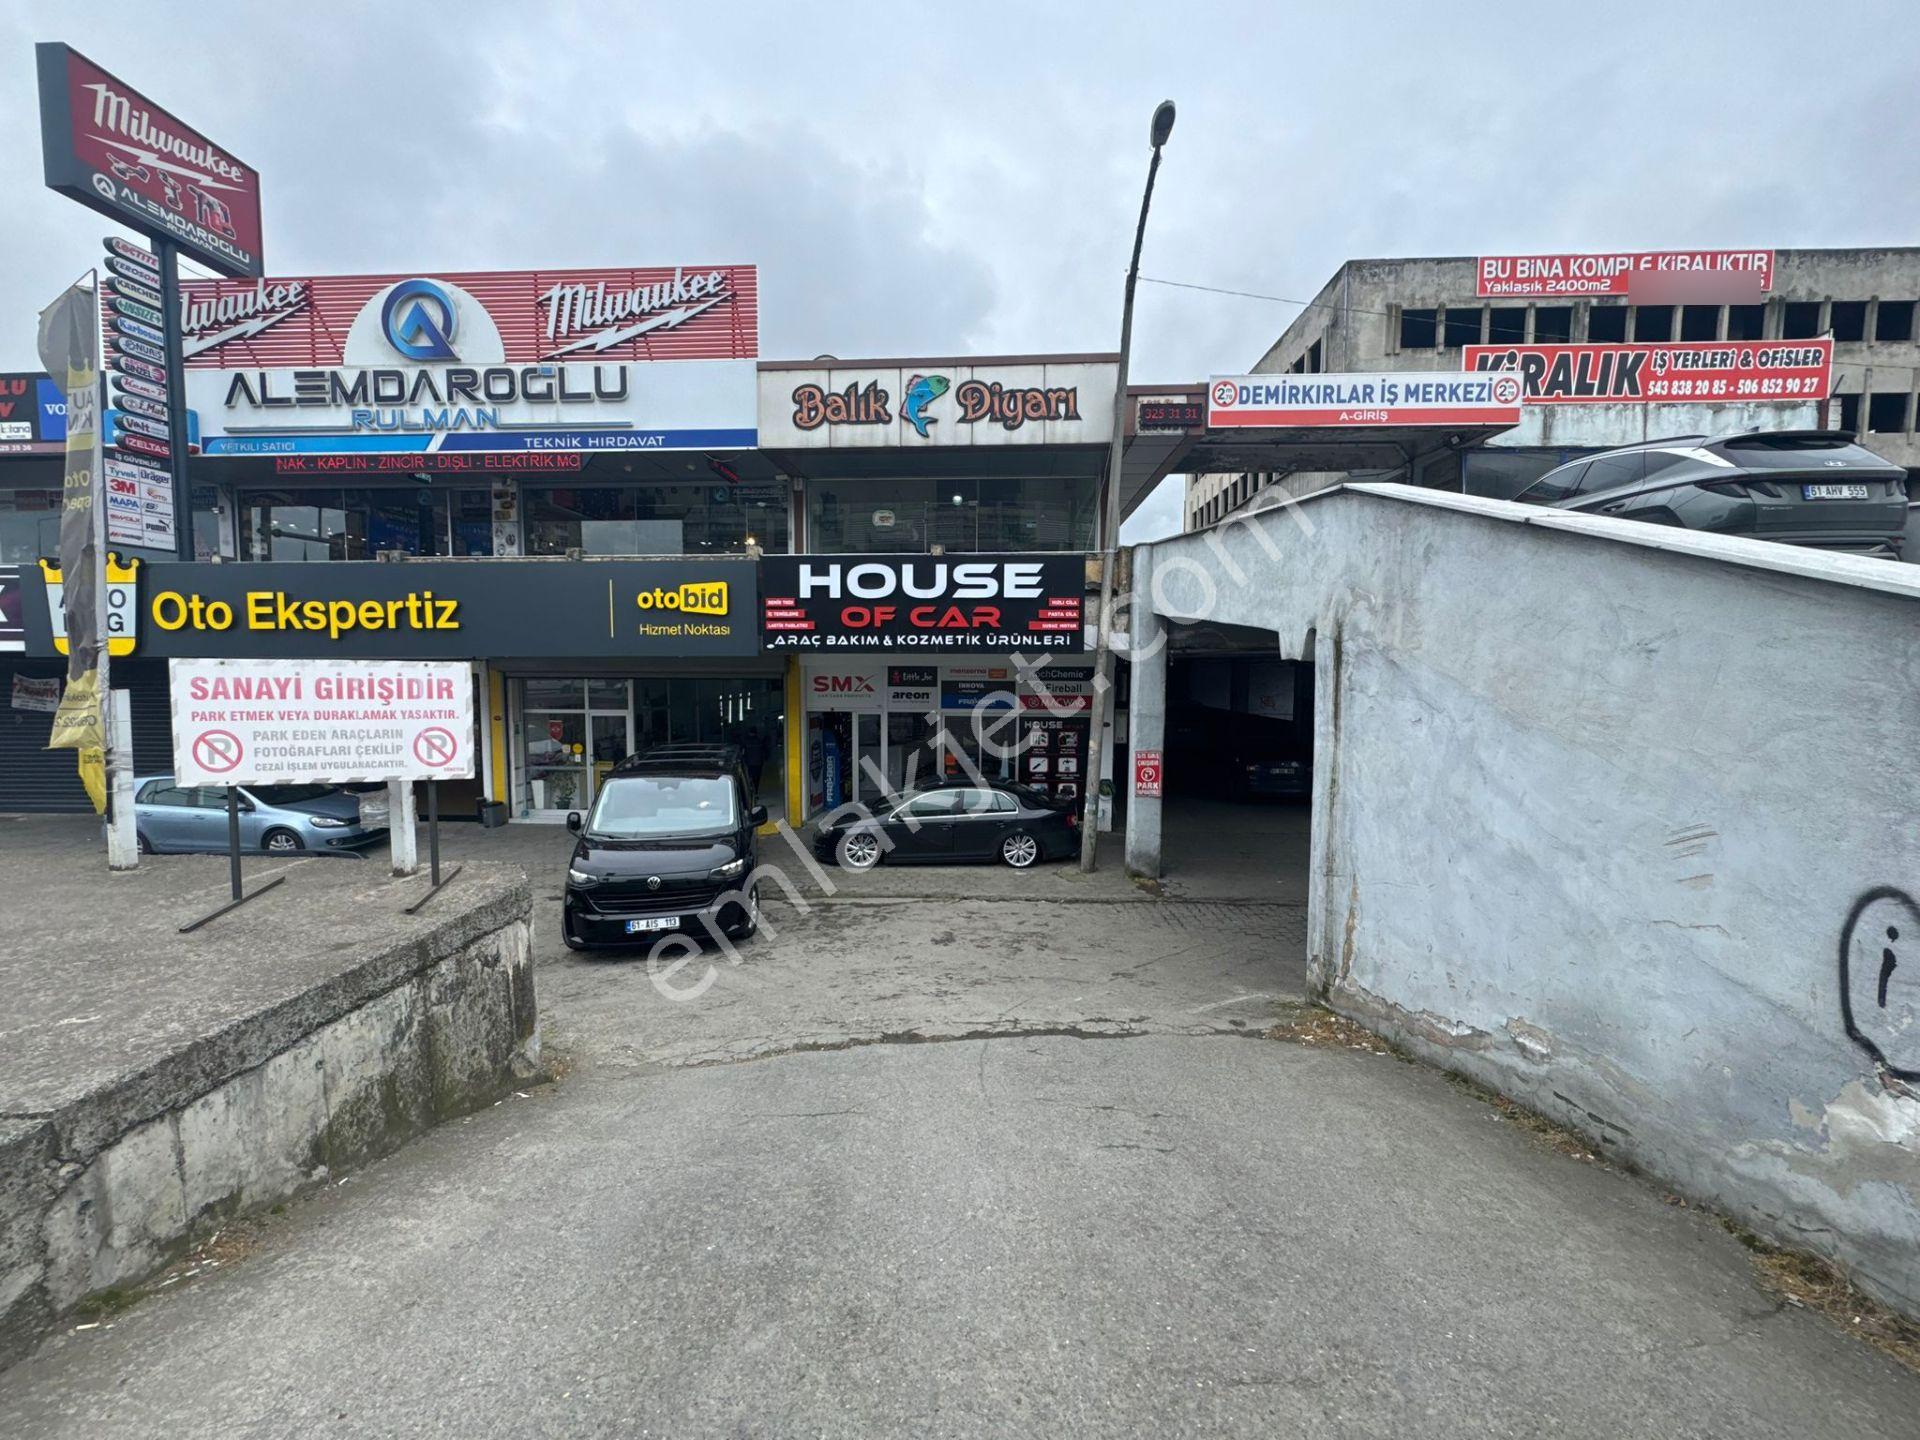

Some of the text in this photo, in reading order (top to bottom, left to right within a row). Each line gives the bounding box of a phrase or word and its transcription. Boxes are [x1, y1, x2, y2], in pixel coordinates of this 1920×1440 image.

[81, 83, 243, 182] Milwaukee
[114, 240, 158, 267] LOCTITE
[115, 261, 160, 286] TEROSON
[1483, 259, 1511, 279] BU
[1484, 278, 1611, 294] Yaklaşık 2400m2
[537, 267, 725, 342] Milwaukee
[1739, 349, 1753, 370] &
[1238, 377, 1494, 405] DEMİRKIRLAR İŞ MERKEZİ
[1648, 380, 1669, 395] 543
[1671, 380, 1692, 395] 838
[1694, 380, 1709, 395] 20
[1712, 380, 1727, 394] 85
[1737, 379, 1758, 394] 506
[1761, 378, 1783, 393] 852
[1785, 378, 1800, 393] 90
[1802, 377, 1819, 392] 27
[792, 379, 1082, 431] Balık Diyarı
[352, 408, 500, 430] RULMAN
[1339, 408, 1388, 422] A-GİRİŞ
[523, 434, 666, 448] TEKNİK HIRDAVAT
[109, 467, 136, 478] Tyvek
[110, 478, 136, 495] 3M
[1810, 485, 1866, 497] 61 AHV 555
[110, 496, 139, 508] MAPA
[799, 563, 1045, 599] HOUSE
[637, 587, 724, 610] otobid
[152, 590, 233, 630] Oto
[246, 590, 460, 639] Ekspertiz
[840, 606, 1001, 628] OF CAR
[640, 623, 731, 636] Hizmet Noktası
[774, 632, 1071, 648] ARAÇ BAKIM & KOZMETİK ÜRÜNLERİ
[190, 671, 454, 705] SANAYİ GİRİŞİDİR
[813, 673, 875, 693] SMX
[892, 690, 930, 700] areon
[191, 709, 460, 722] PARK ETMEK VEYA DURAKLAMAK YASAKTIR.
[1024, 720, 1063, 729] HOUSE
[253, 729, 404, 742] PARK EDEN ARAÇLARIN
[253, 743, 404, 758] FOTOĞRAFLARI ÇEKİLİP
[1137, 781, 1159, 790] PARK
[631, 919, 641, 930] 61
[665, 917, 677, 927] 113
